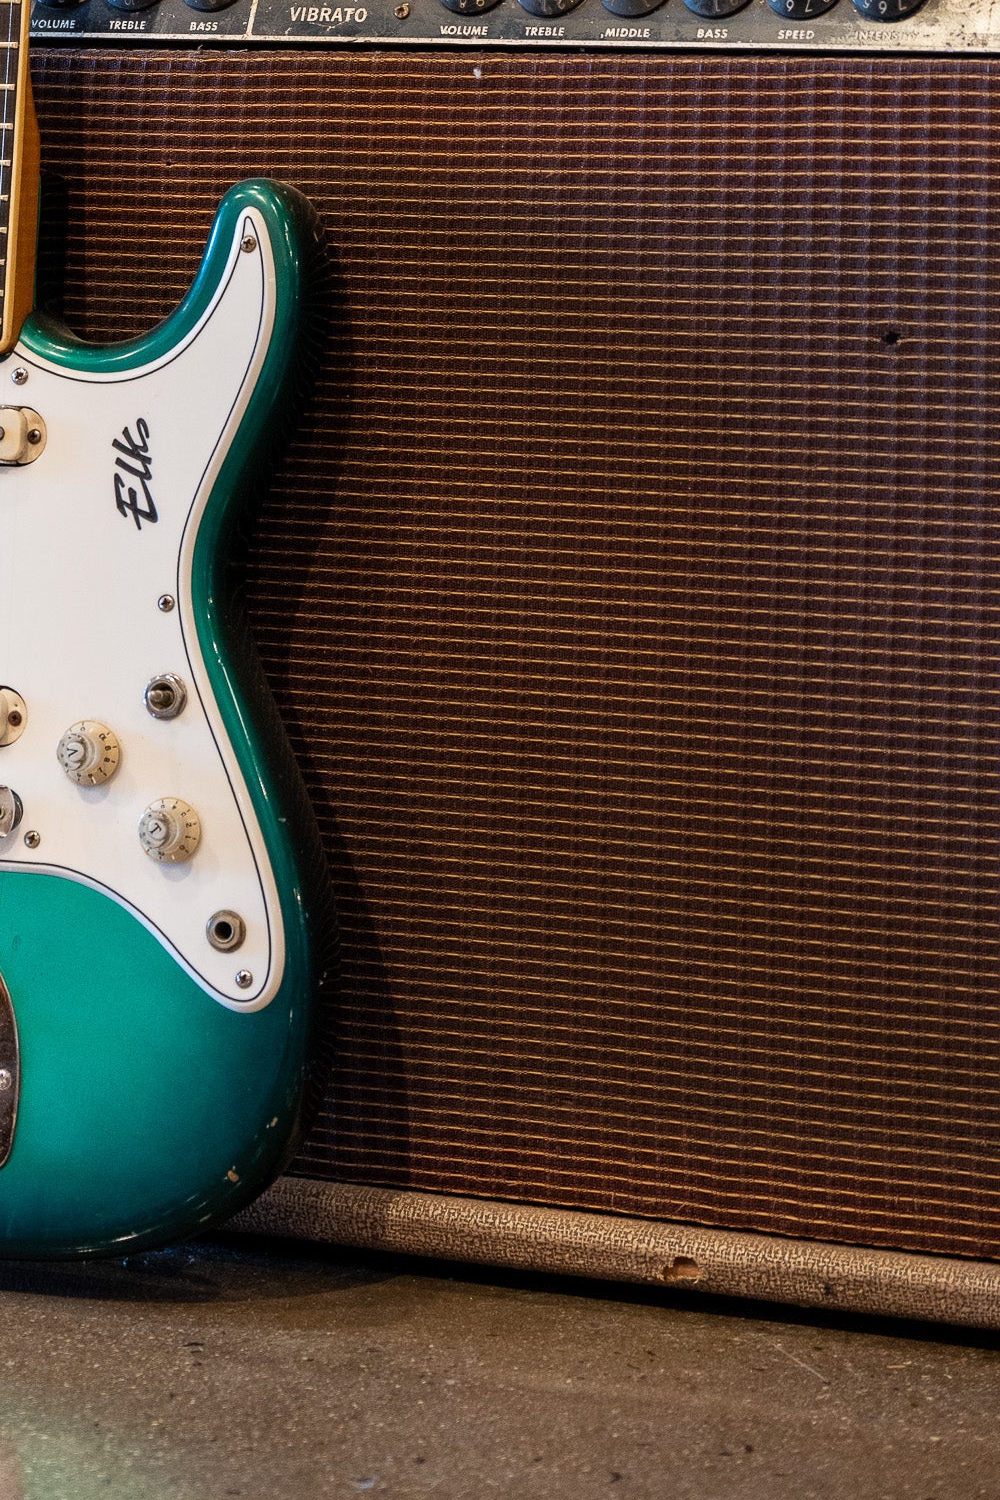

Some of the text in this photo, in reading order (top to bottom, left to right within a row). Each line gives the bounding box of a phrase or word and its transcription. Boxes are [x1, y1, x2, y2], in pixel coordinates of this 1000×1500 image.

[290, 7, 368, 23] VIBRATO
[31, 19, 76, 29] VOLUME
[109, 20, 147, 30] TREBLE
[189, 22, 218, 31] BASS
[440, 25, 488, 36] VOLUME
[525, 26, 565, 37] TREBLE
[604, 28, 650, 38] MIDDLE
[696, 28, 728, 39] BASS
[777, 29, 815, 40] SPEED
[112, 417, 158, 531] Elk
[150, 822, 162, 834] T
